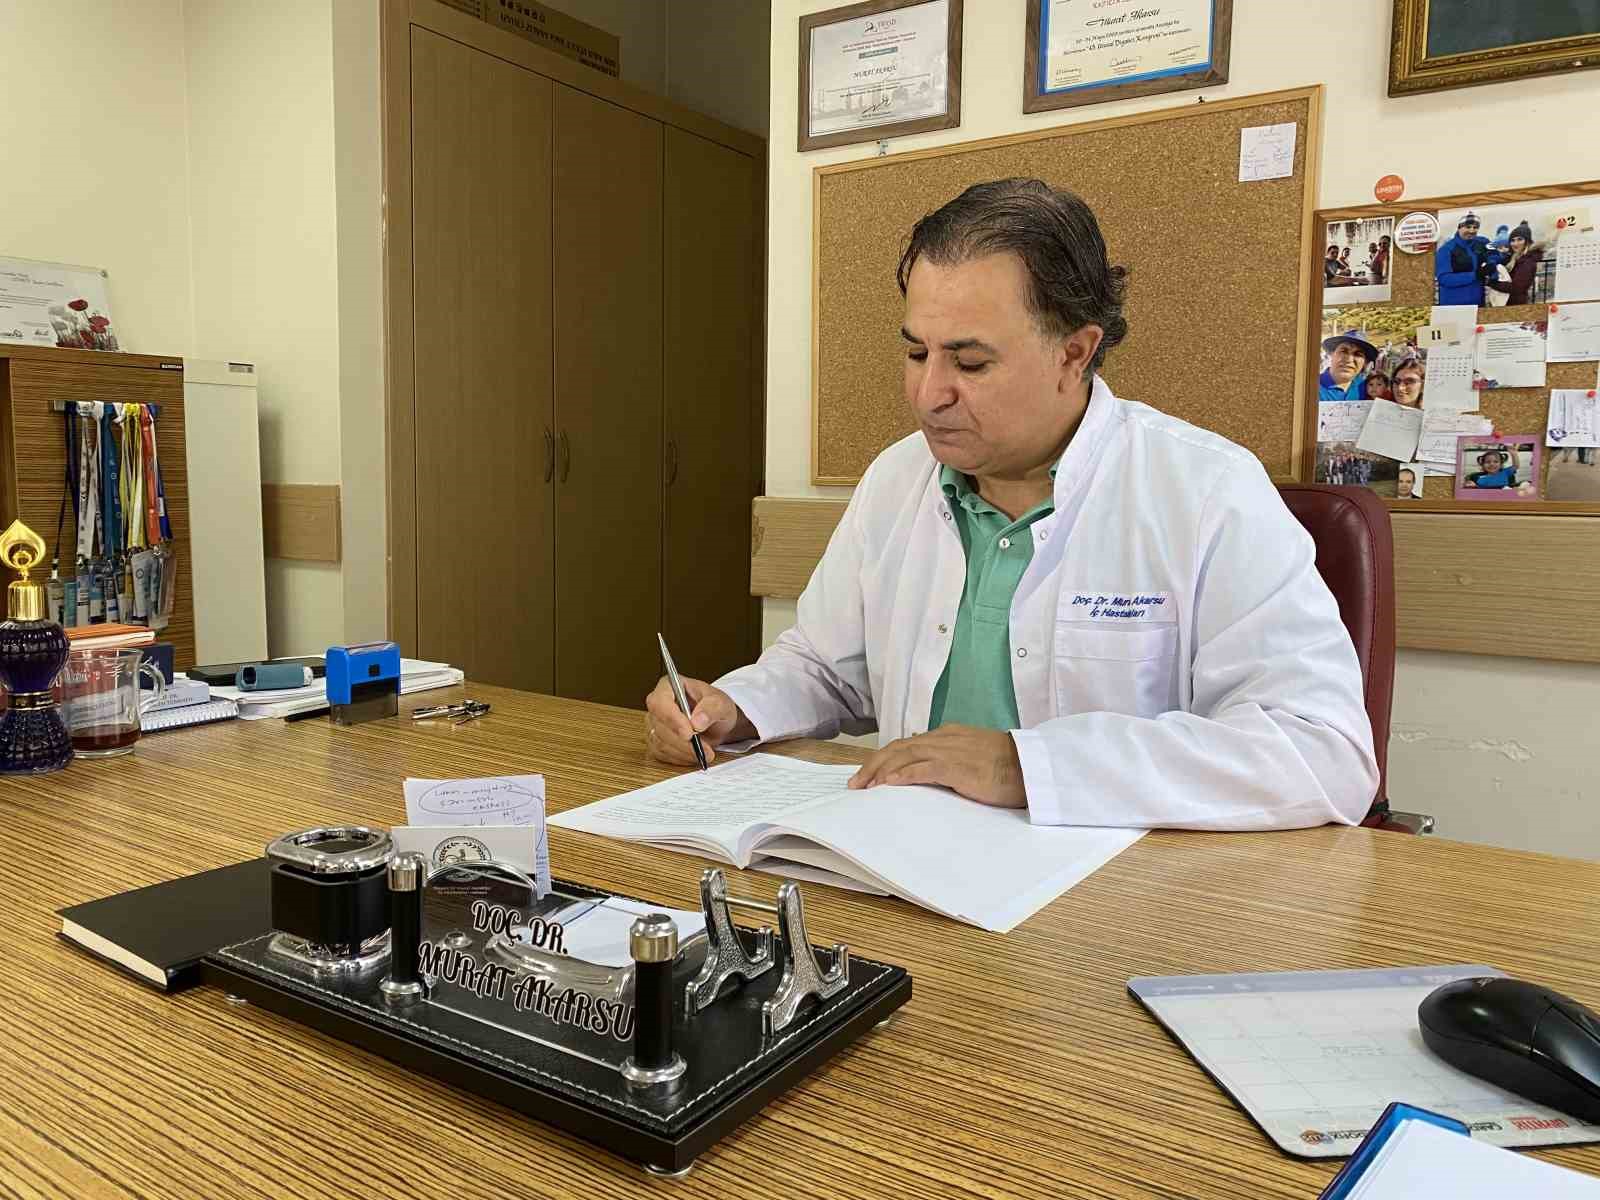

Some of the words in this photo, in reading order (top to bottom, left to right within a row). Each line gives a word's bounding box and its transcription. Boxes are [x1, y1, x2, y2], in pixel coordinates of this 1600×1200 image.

[1431, 330, 1441, 340] 11
[1094, 596, 1108, 605] Dr.
[528, 916, 568, 956] DR.
[418, 940, 516, 1001] MURAT
[513, 975, 635, 1042] AKARSU
